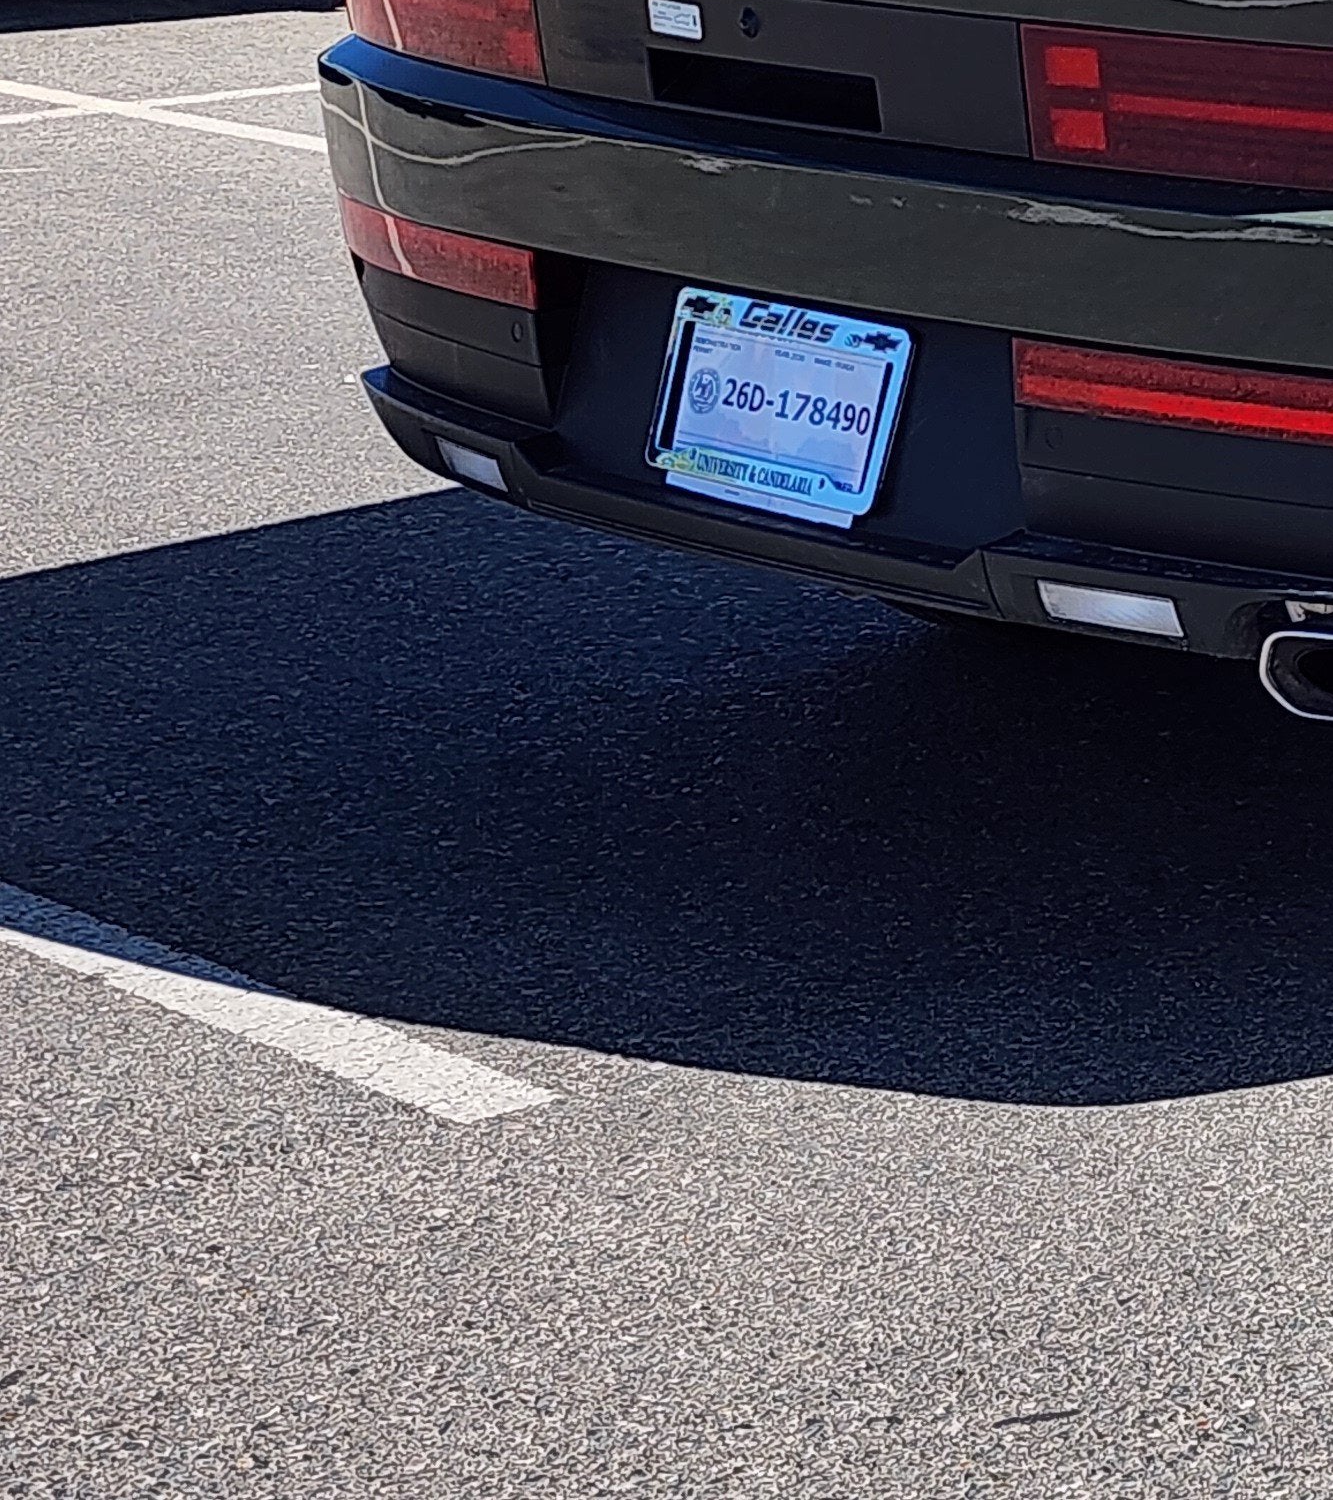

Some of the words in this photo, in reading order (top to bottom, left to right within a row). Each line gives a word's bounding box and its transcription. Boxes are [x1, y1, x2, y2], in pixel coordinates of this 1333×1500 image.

[738, 300, 840, 343] Galles
[721, 378, 871, 436] 26D-178490
[696, 453, 750, 482] UNIVERSITY
[756, 466, 814, 497] CANDELARIA
